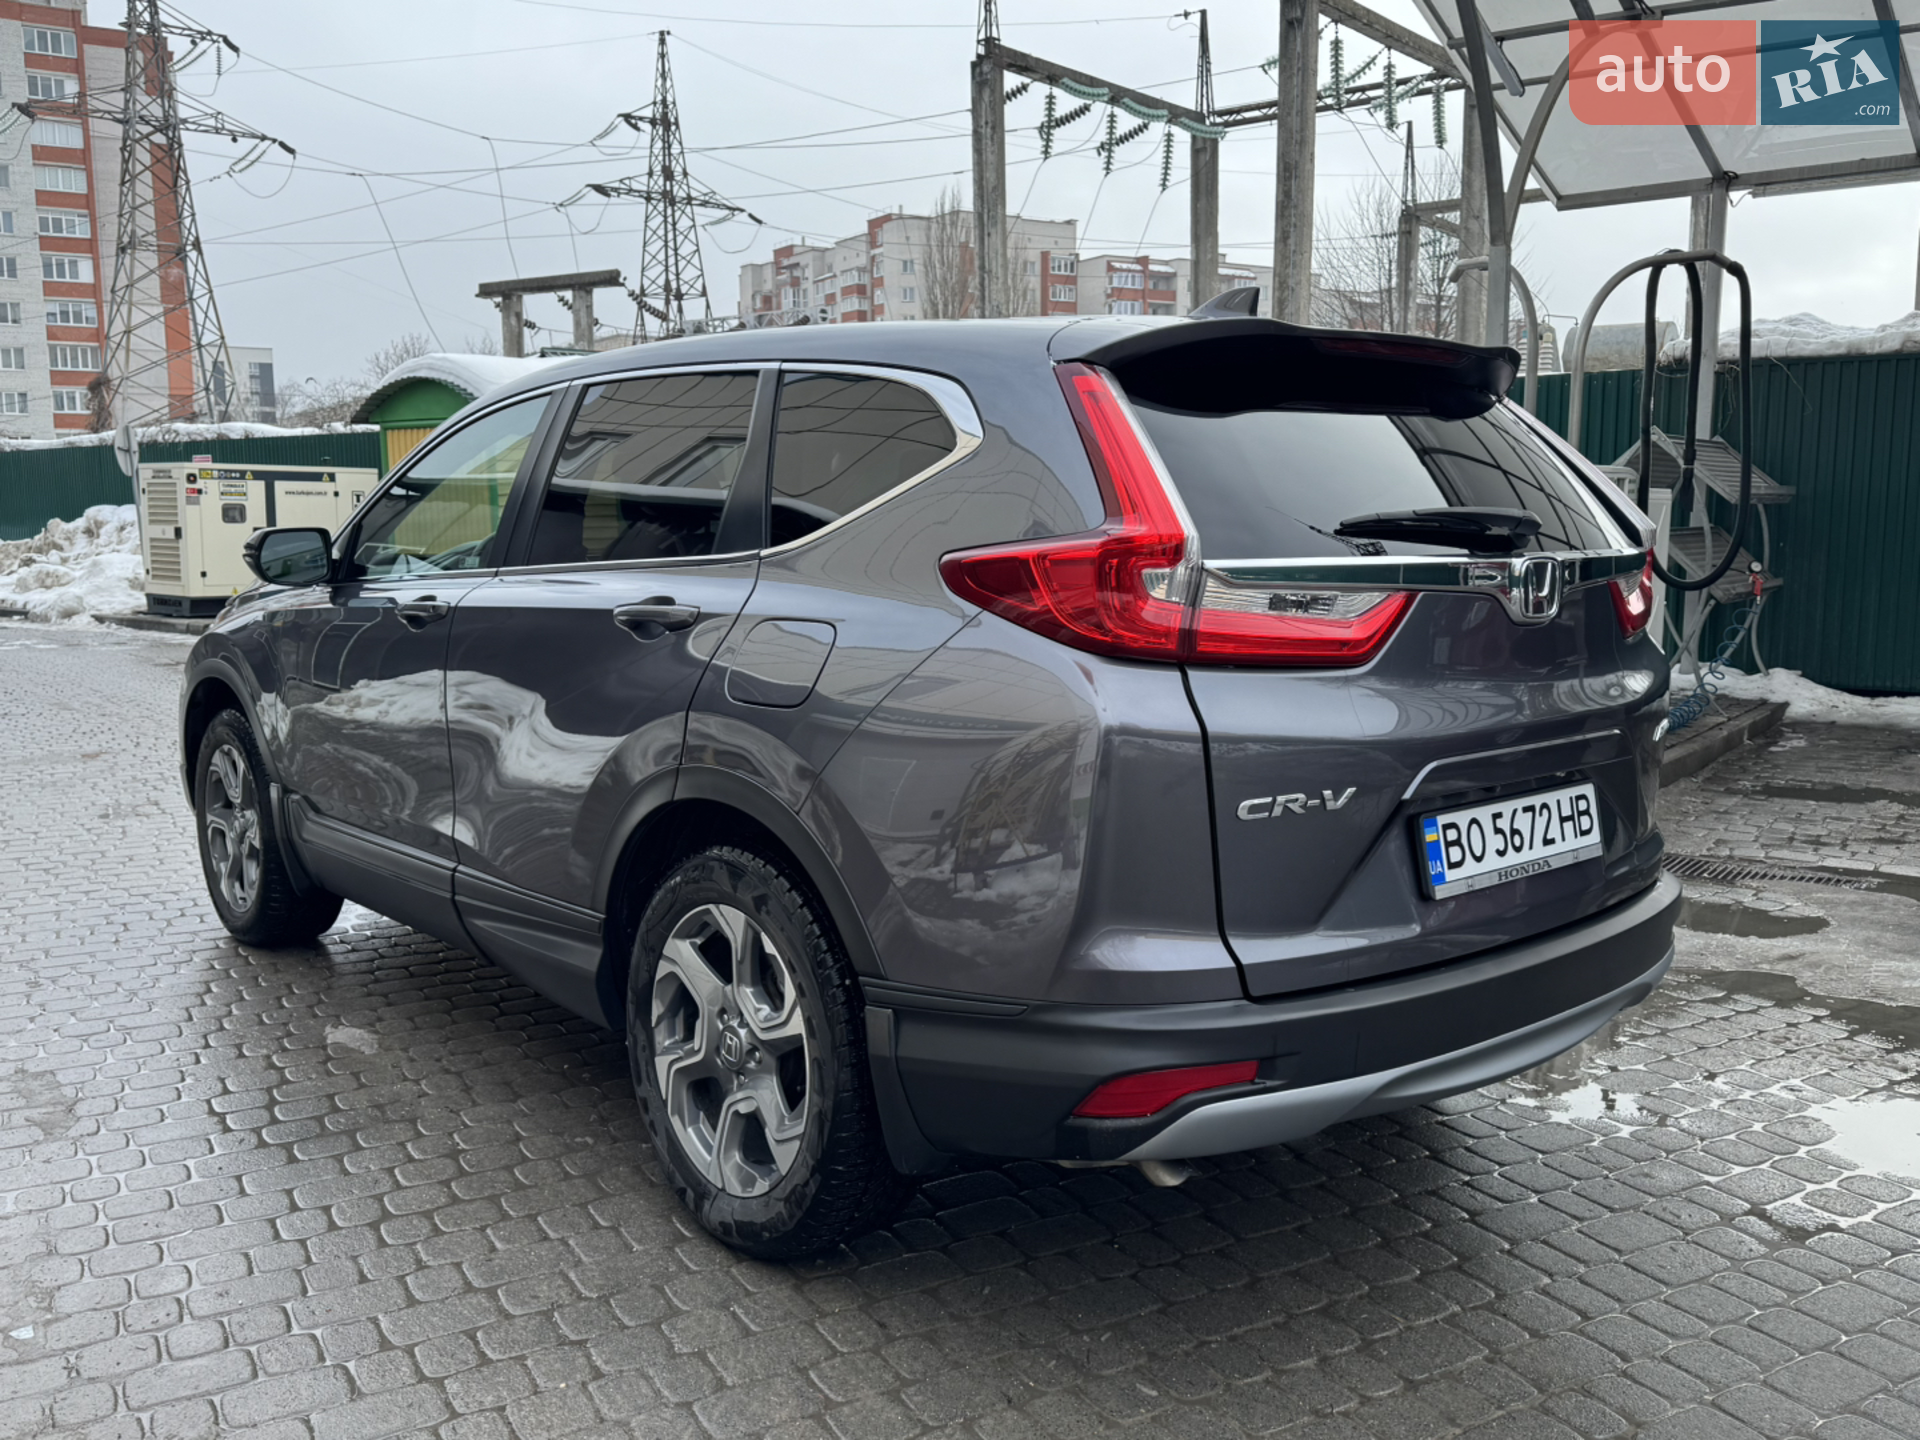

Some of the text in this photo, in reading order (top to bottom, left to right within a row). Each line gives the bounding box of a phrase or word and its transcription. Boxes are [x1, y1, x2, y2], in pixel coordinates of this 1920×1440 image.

[1236, 786, 1357, 821] CR-V
[1441, 793, 1594, 870] BO 5672 HB
[1429, 860, 1443, 875] UA
[1497, 859, 1552, 882] HONDA
